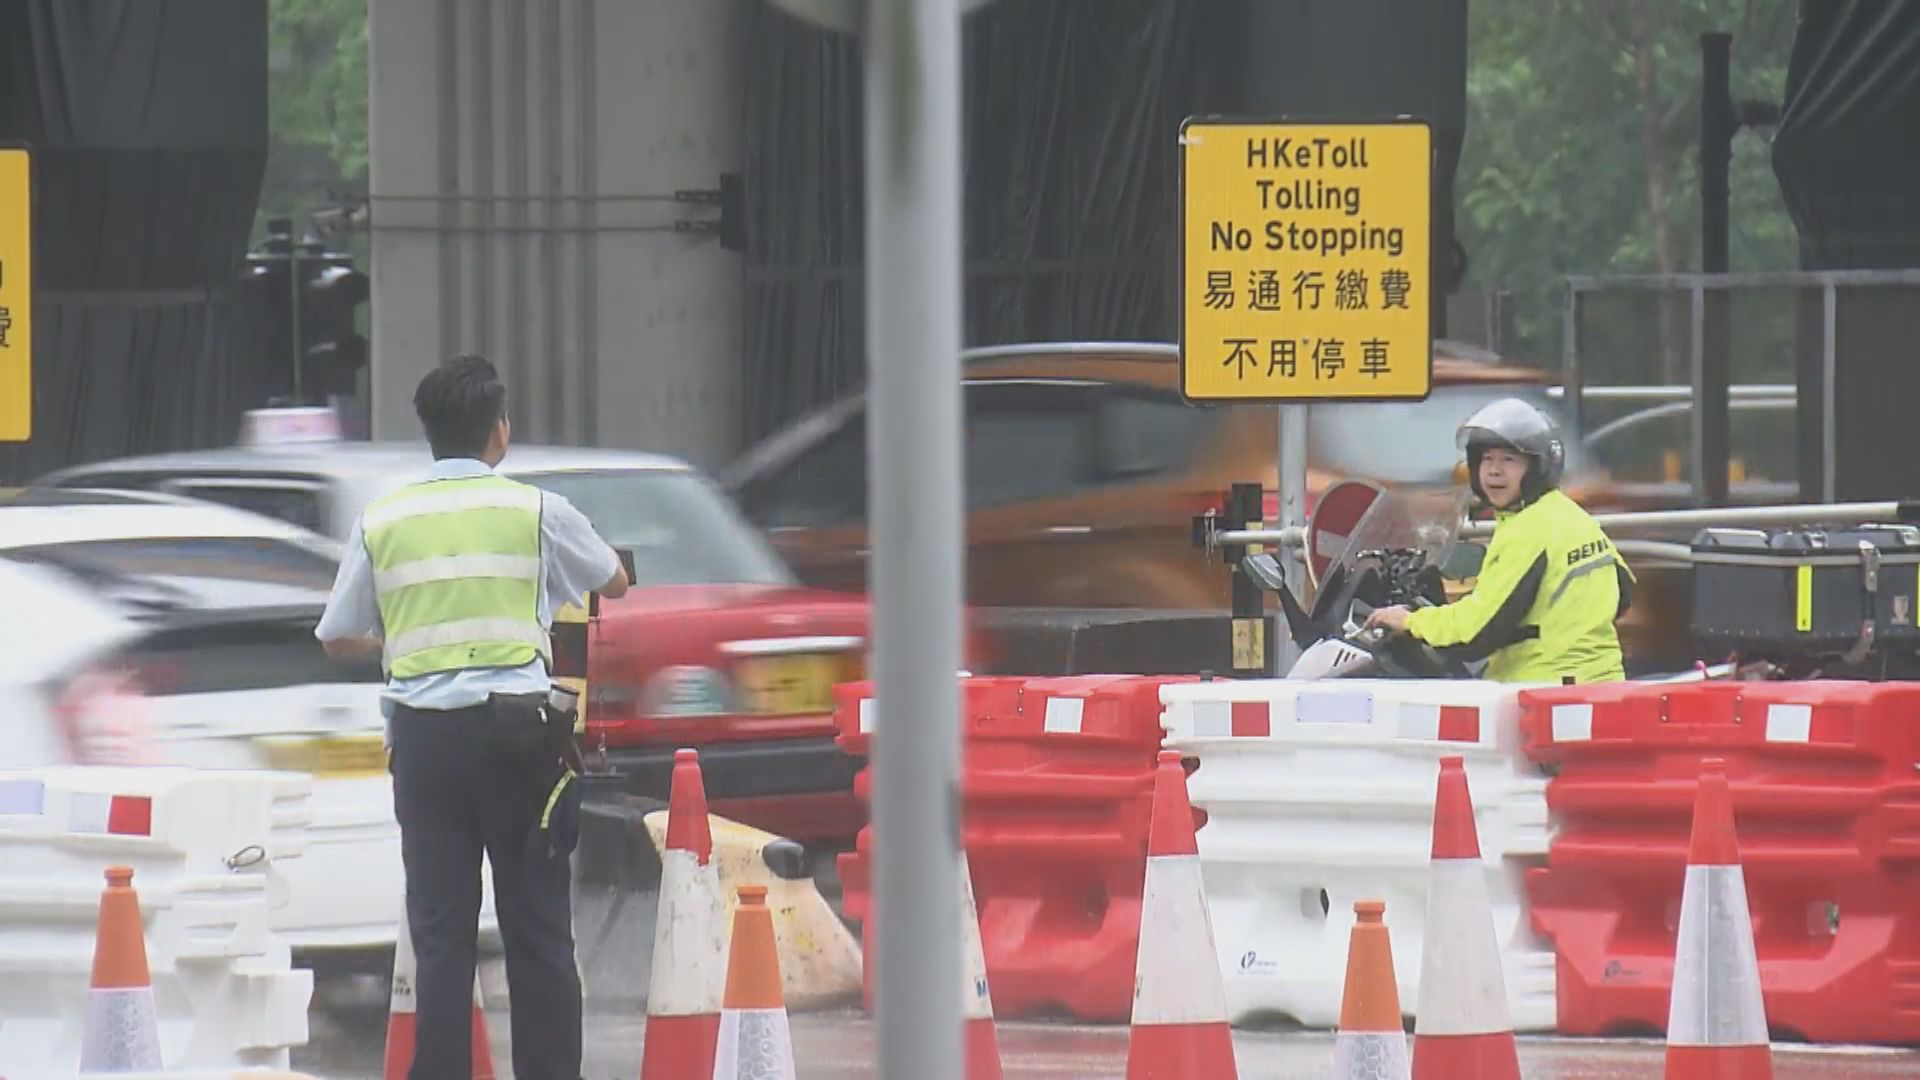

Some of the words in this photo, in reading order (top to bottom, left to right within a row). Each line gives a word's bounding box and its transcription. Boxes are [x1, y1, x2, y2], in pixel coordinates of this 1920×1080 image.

[1247, 138, 1369, 168] HKeToll
[1256, 179, 1360, 215] Tolling
[1211, 221, 1252, 251] No
[1265, 220, 1404, 256] Stopping
[1204, 268, 1412, 311] 易通行繳費
[1222, 337, 1392, 380] 不用停車
